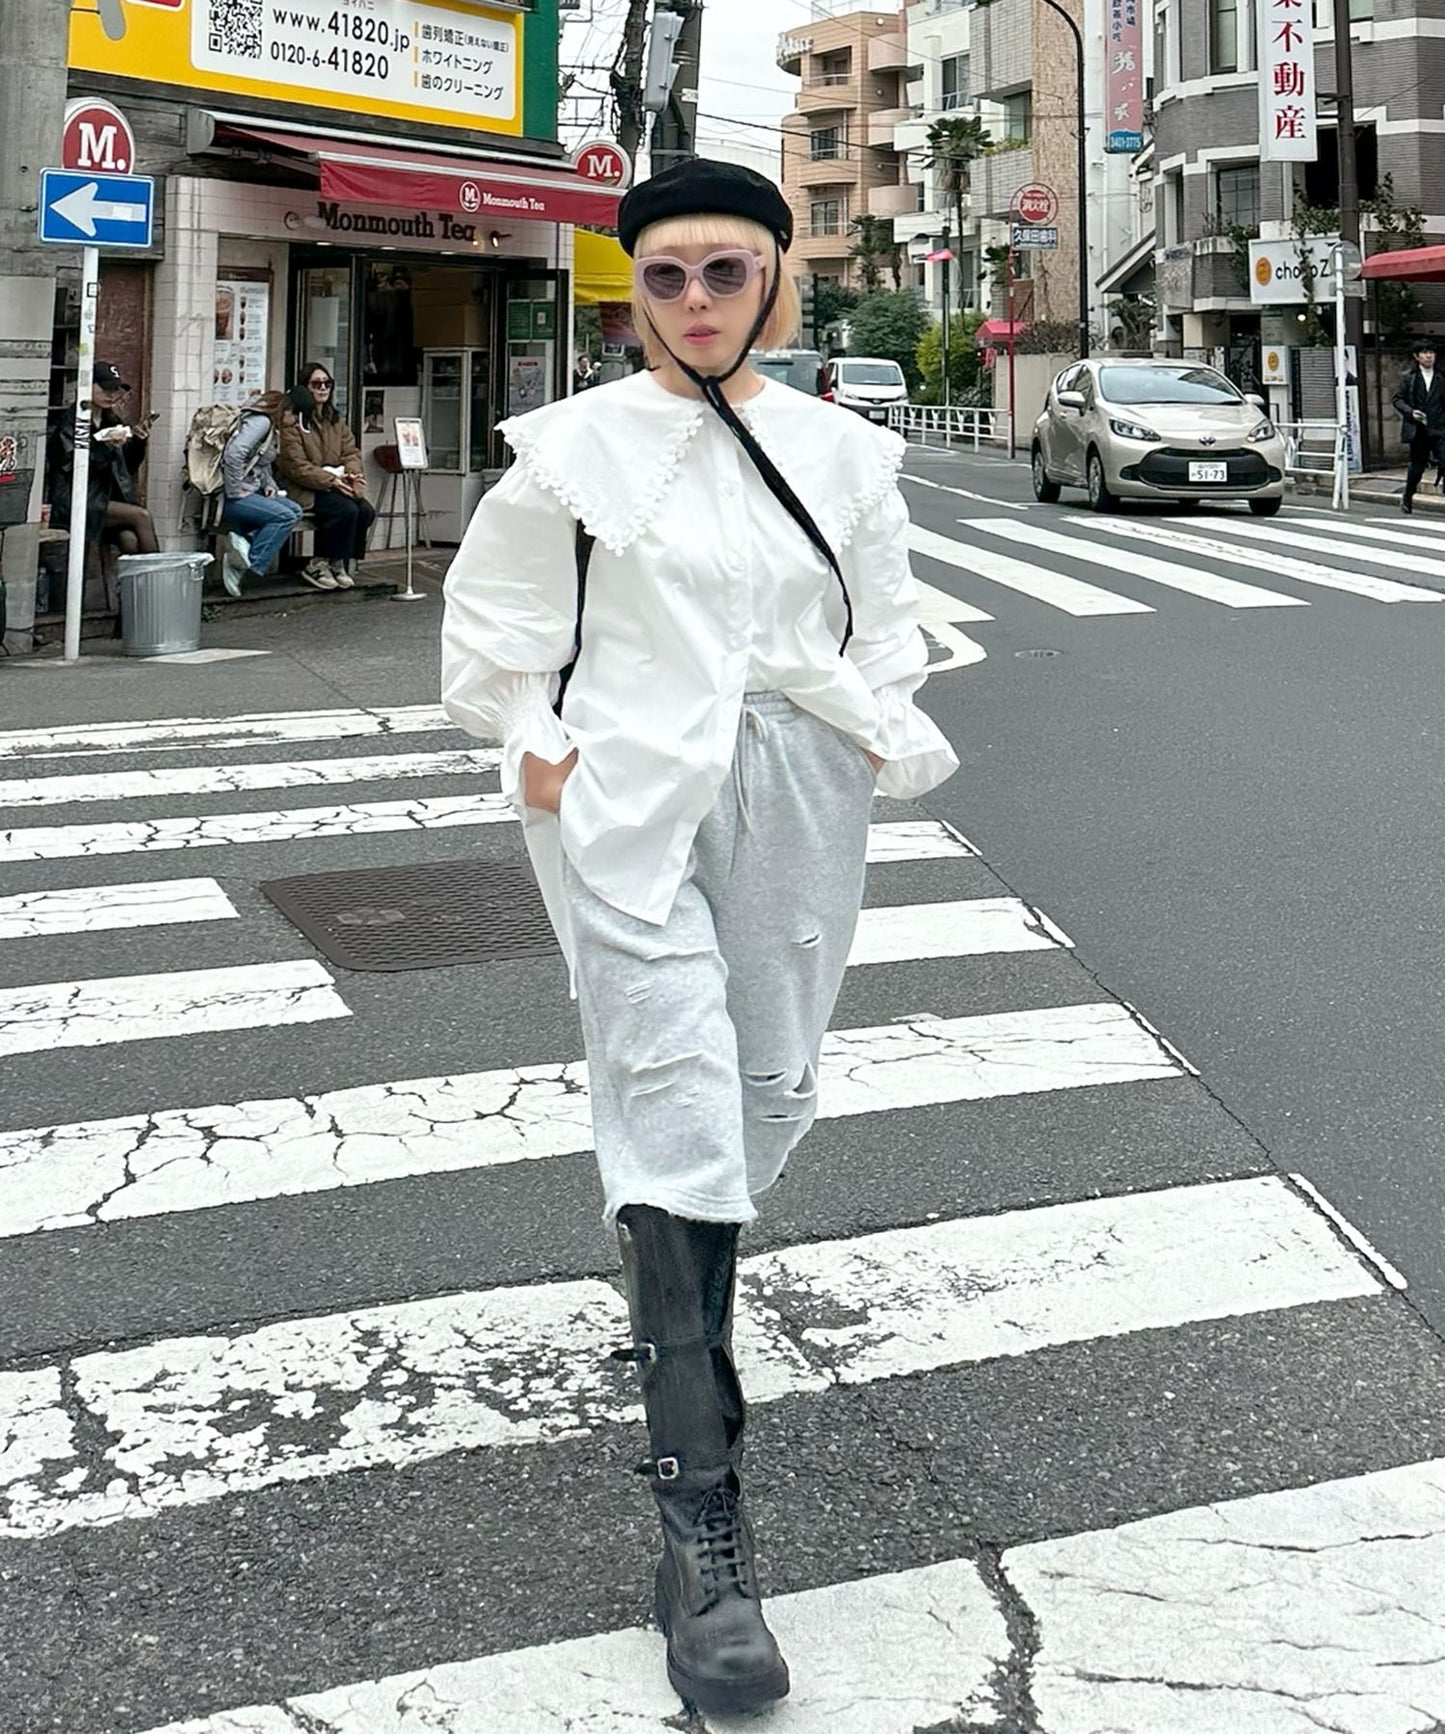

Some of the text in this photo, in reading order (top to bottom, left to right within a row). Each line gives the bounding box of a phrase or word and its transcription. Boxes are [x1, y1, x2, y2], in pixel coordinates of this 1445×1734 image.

[272, 8, 410, 53] www.41820.jp
[270, 41, 390, 80] 0120-6-41820
[421, 48, 493, 75] ホワイトニング
[421, 73, 504, 101] 歯のクリーニング
[482, 193, 545, 211] Monmouth Tea
[1022, 198, 1049, 212] 消火栓
[316, 201, 477, 242] Monmouth Tea
[1013, 229, 1057, 243] 久保田歯科
[1275, 259, 1331, 280] chooZ
